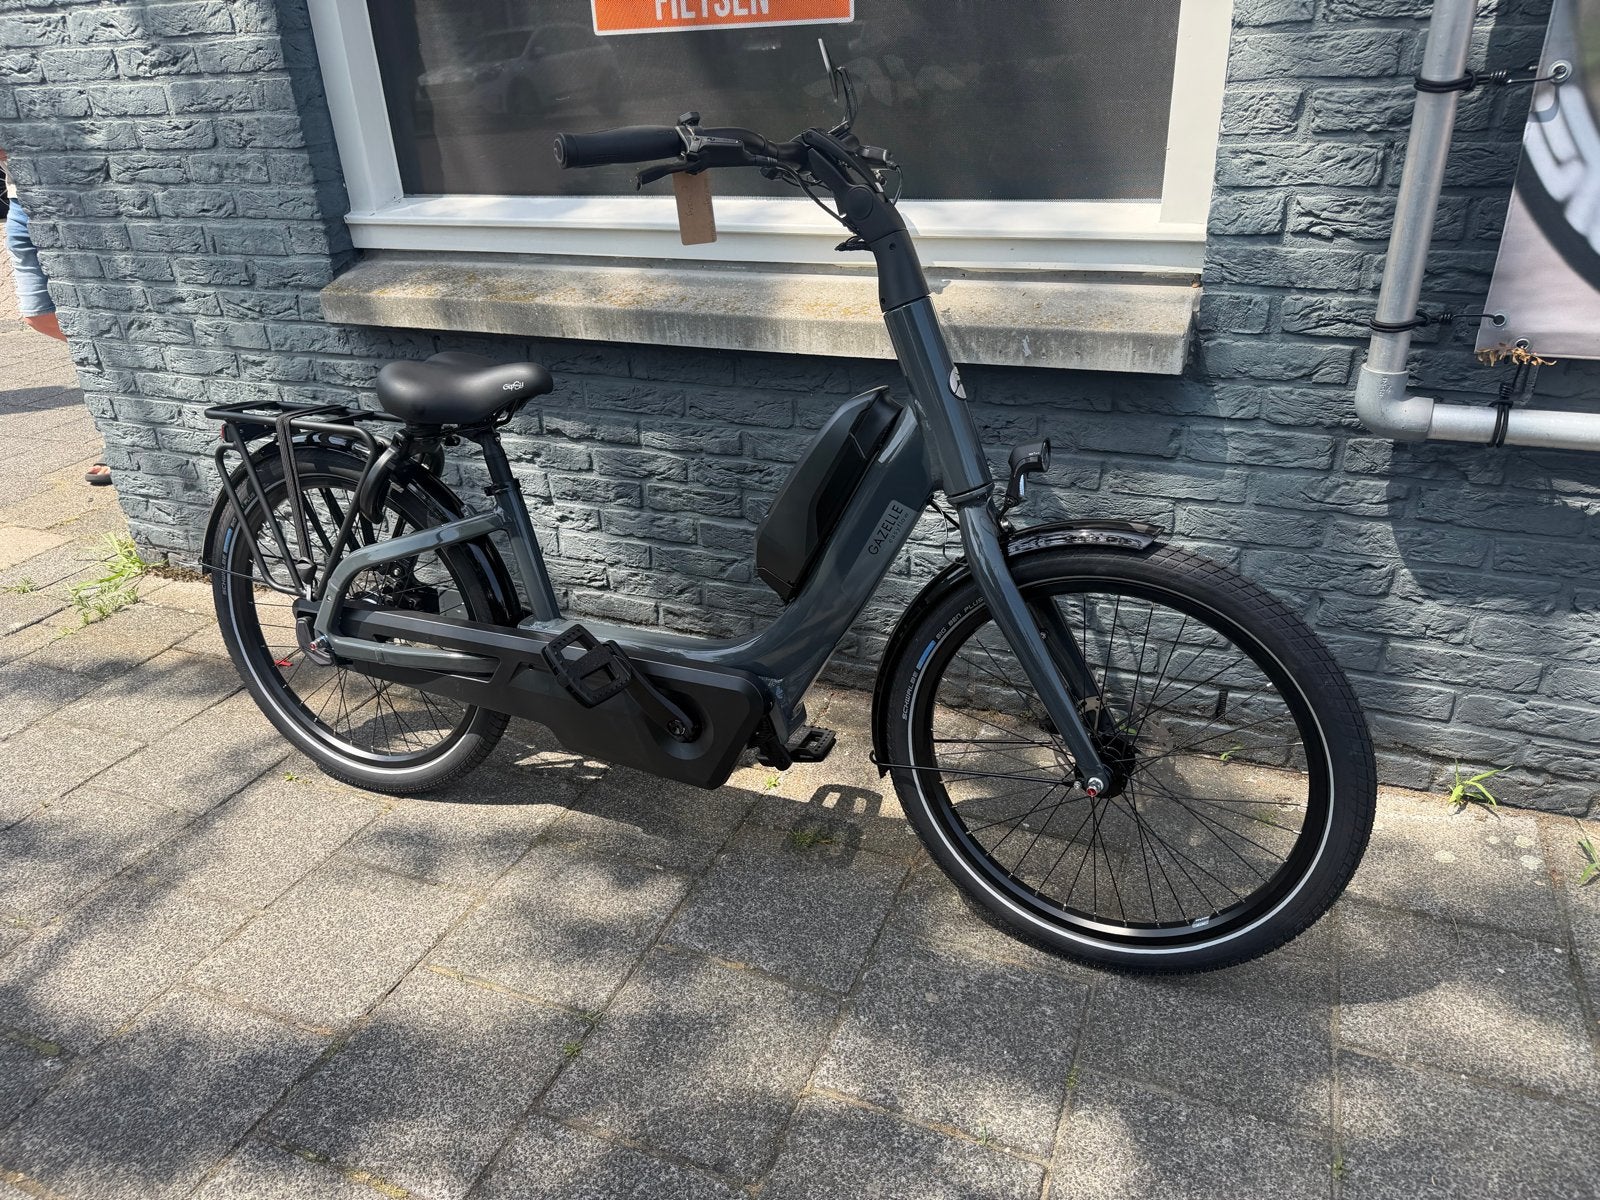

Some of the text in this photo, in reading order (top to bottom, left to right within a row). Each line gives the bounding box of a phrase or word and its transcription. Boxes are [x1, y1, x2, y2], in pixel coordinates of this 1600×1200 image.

[868, 504, 903, 555] GAZELLE
[902, 671, 918, 720] SCHWALBE
[964, 597, 984, 612] PLUS
